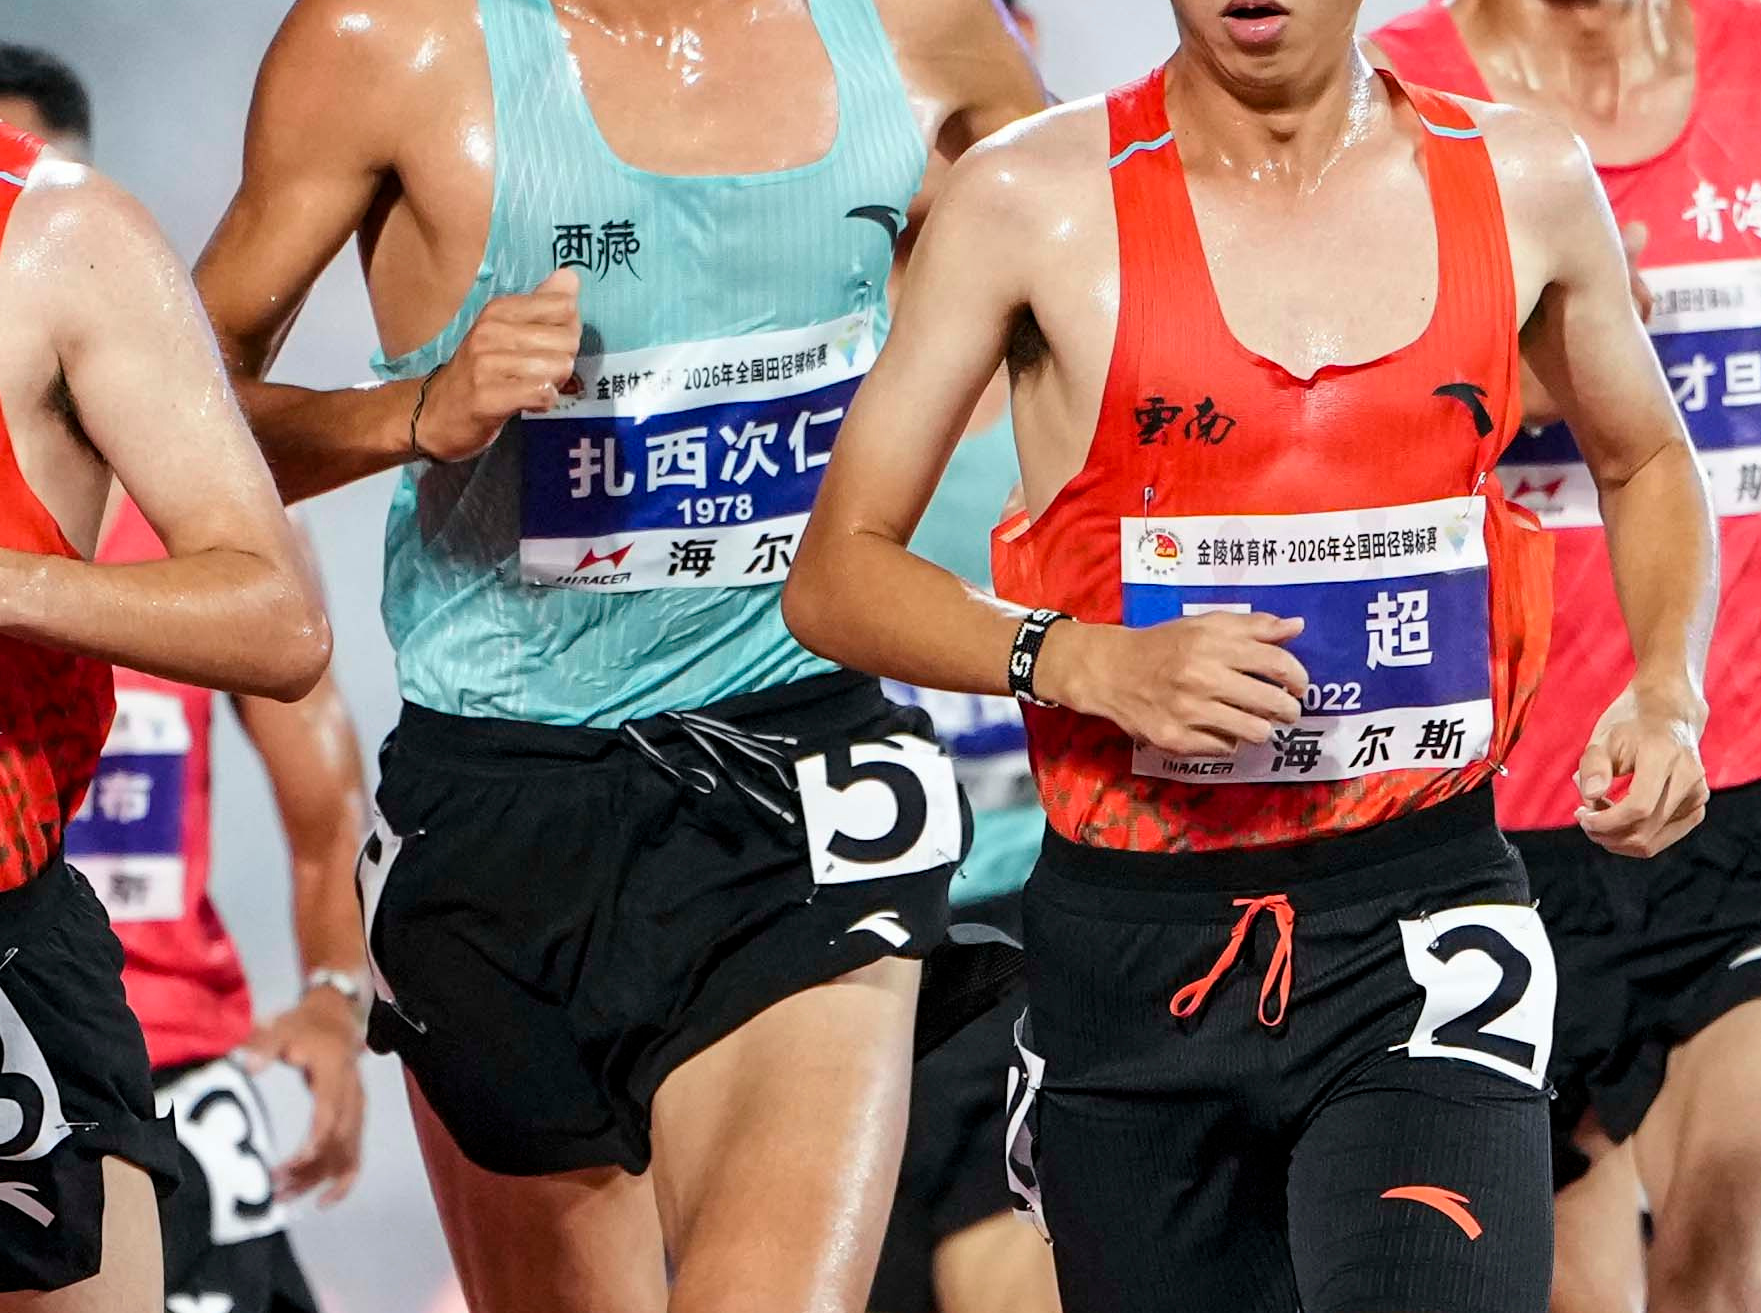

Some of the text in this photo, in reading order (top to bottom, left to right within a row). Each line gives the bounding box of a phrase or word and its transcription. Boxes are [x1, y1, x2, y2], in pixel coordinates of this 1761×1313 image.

[552, 219, 642, 282] 西藏
[568, 407, 844, 499] 扎西次仁
[676, 493, 755, 525] 1978
[1196, 526, 1438, 566] 金陵体育杯·2026年全国田径锦标赛
[1301, 681, 1362, 712] 022
[1270, 718, 1466, 774] 海尔斯
[1426, 924, 1537, 1074] 2
[187, 1088, 274, 1218] 3
